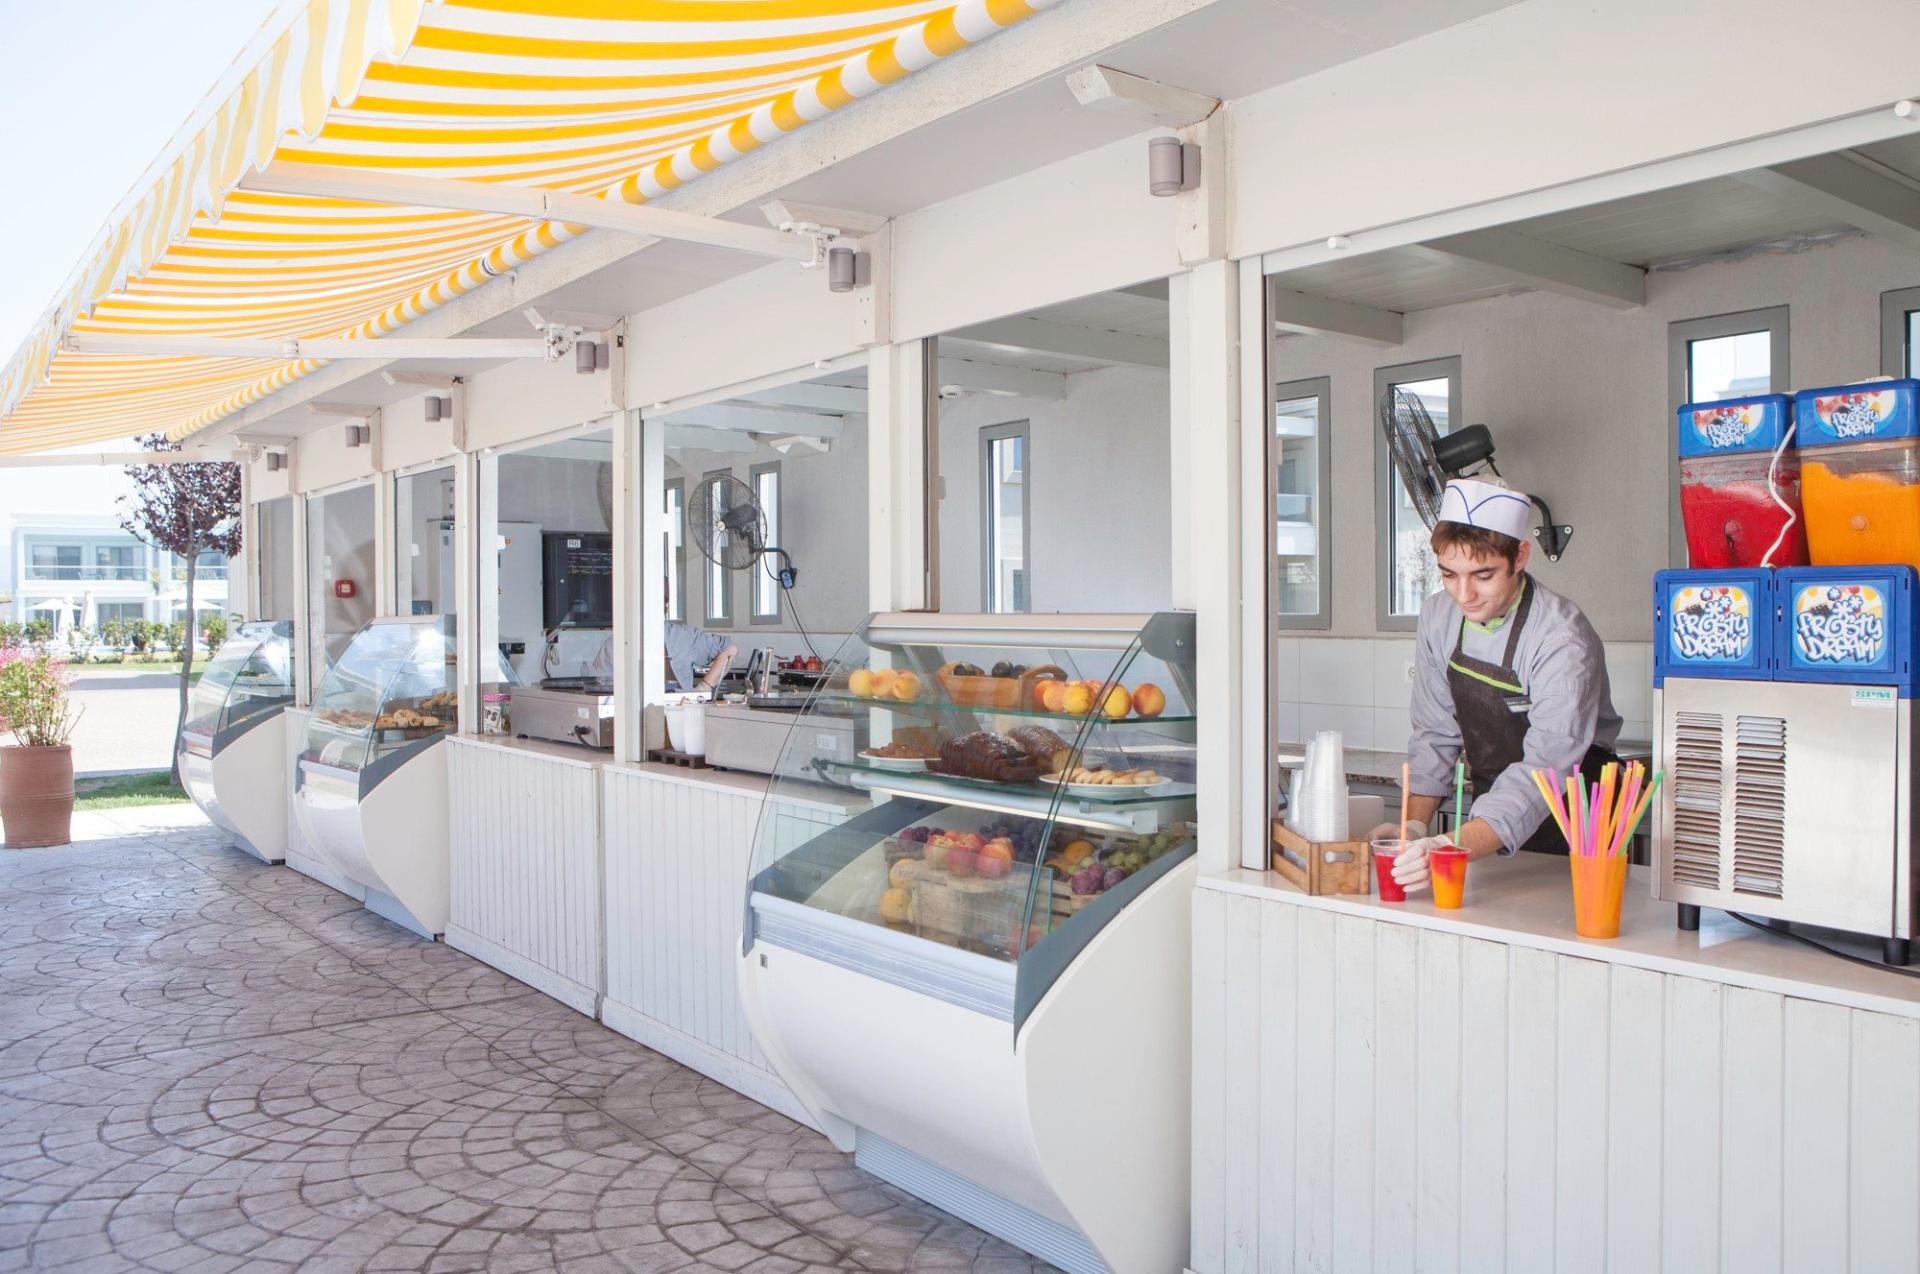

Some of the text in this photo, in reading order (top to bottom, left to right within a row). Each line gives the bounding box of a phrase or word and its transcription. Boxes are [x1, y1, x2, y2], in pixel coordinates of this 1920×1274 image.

[1836, 421, 1875, 439] DREAM
[1681, 634, 1744, 659] DREAM
[1806, 635, 1875, 663] DREAM
